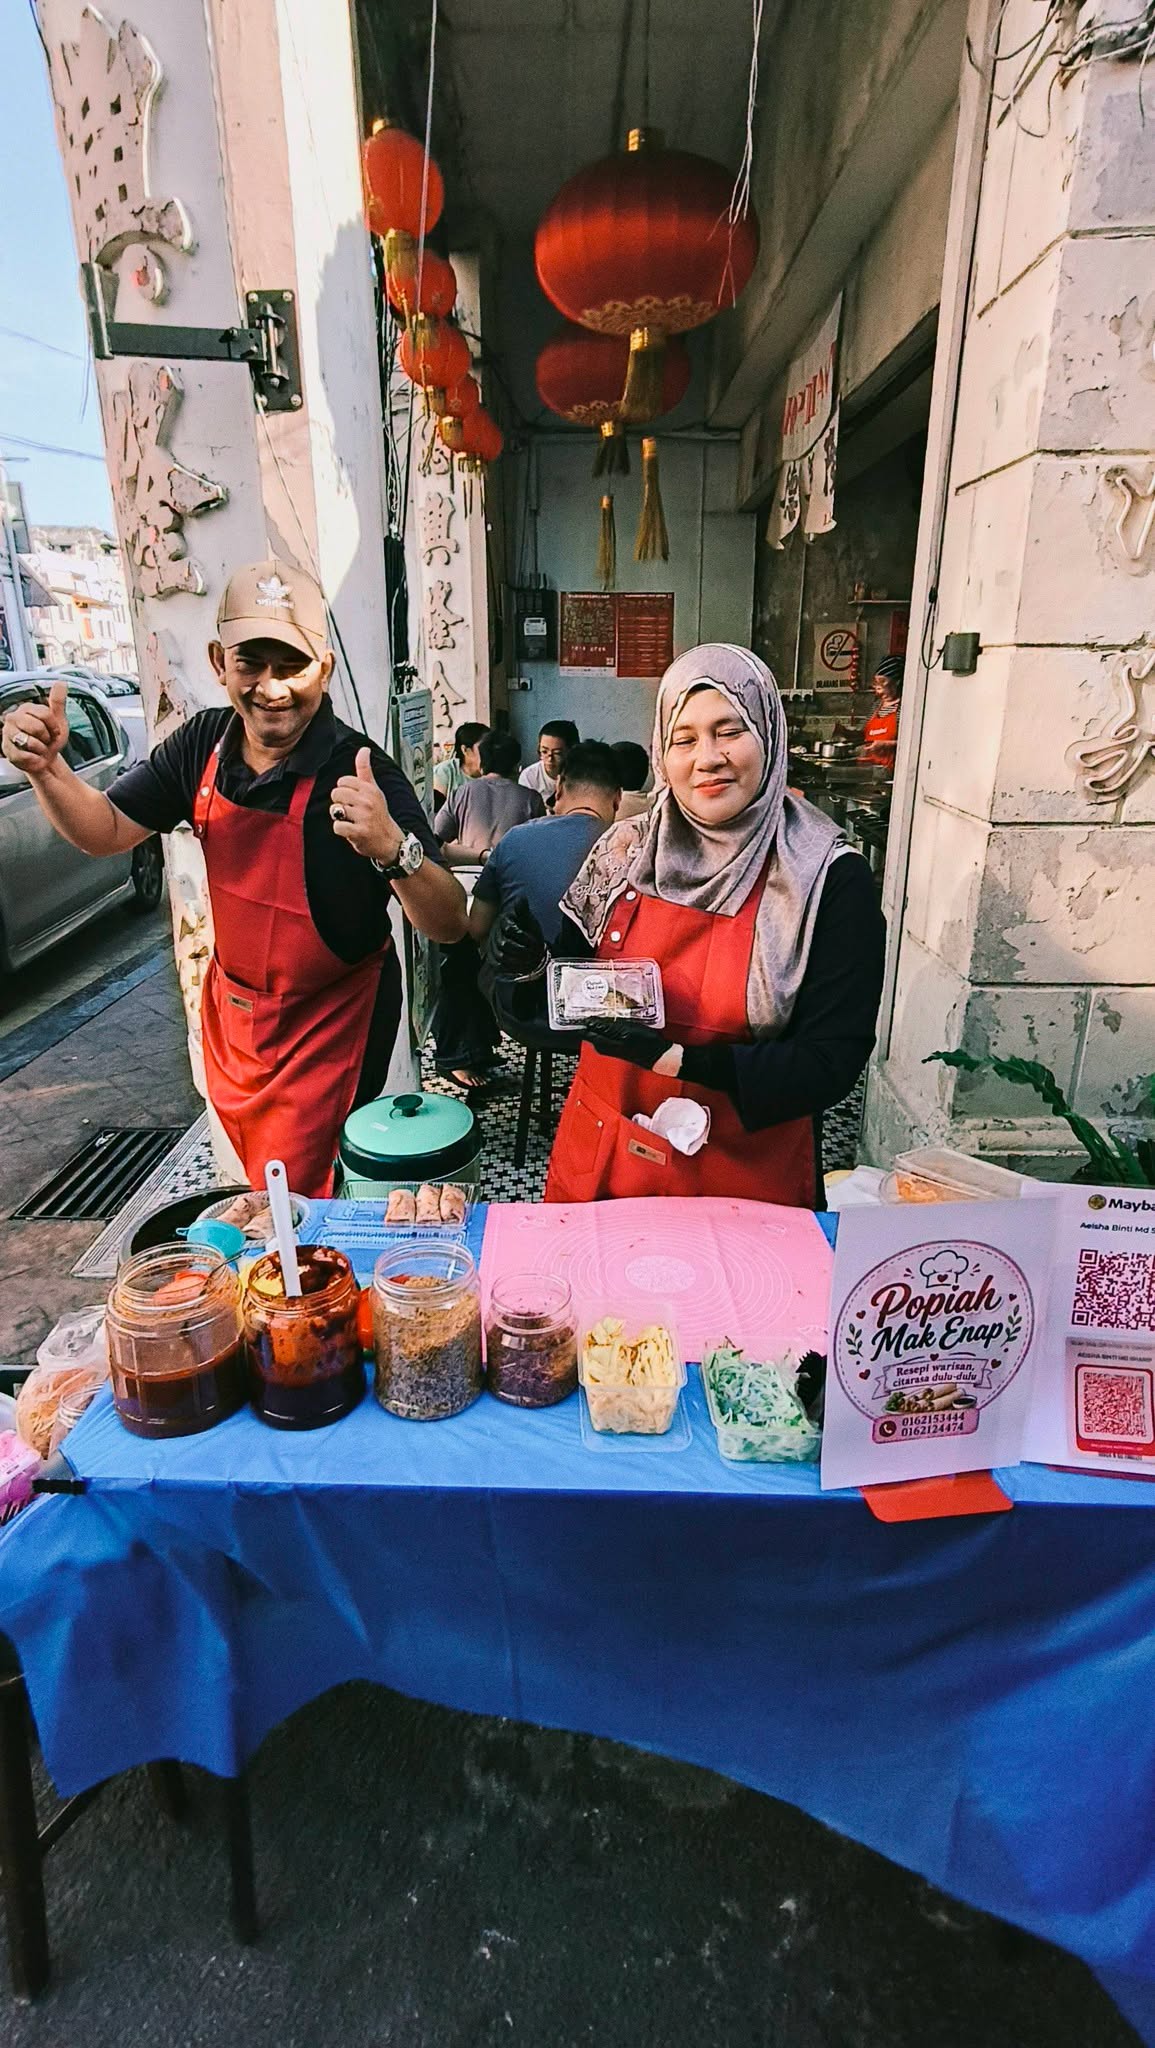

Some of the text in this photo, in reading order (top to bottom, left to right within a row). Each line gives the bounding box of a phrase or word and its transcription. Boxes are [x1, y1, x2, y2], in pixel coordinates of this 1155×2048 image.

[1080, 1222, 1110, 1231] Aeisha
[871, 1274, 1002, 1329] Popiah
[870, 1316, 1004, 1362] Mak Enap
[896, 1362, 975, 1376] Resepi warisan,
[893, 1372, 977, 1387] citarasa dulu-dulu
[902, 1412, 965, 1427] 0162153444
[901, 1422, 964, 1437] 0162124474
